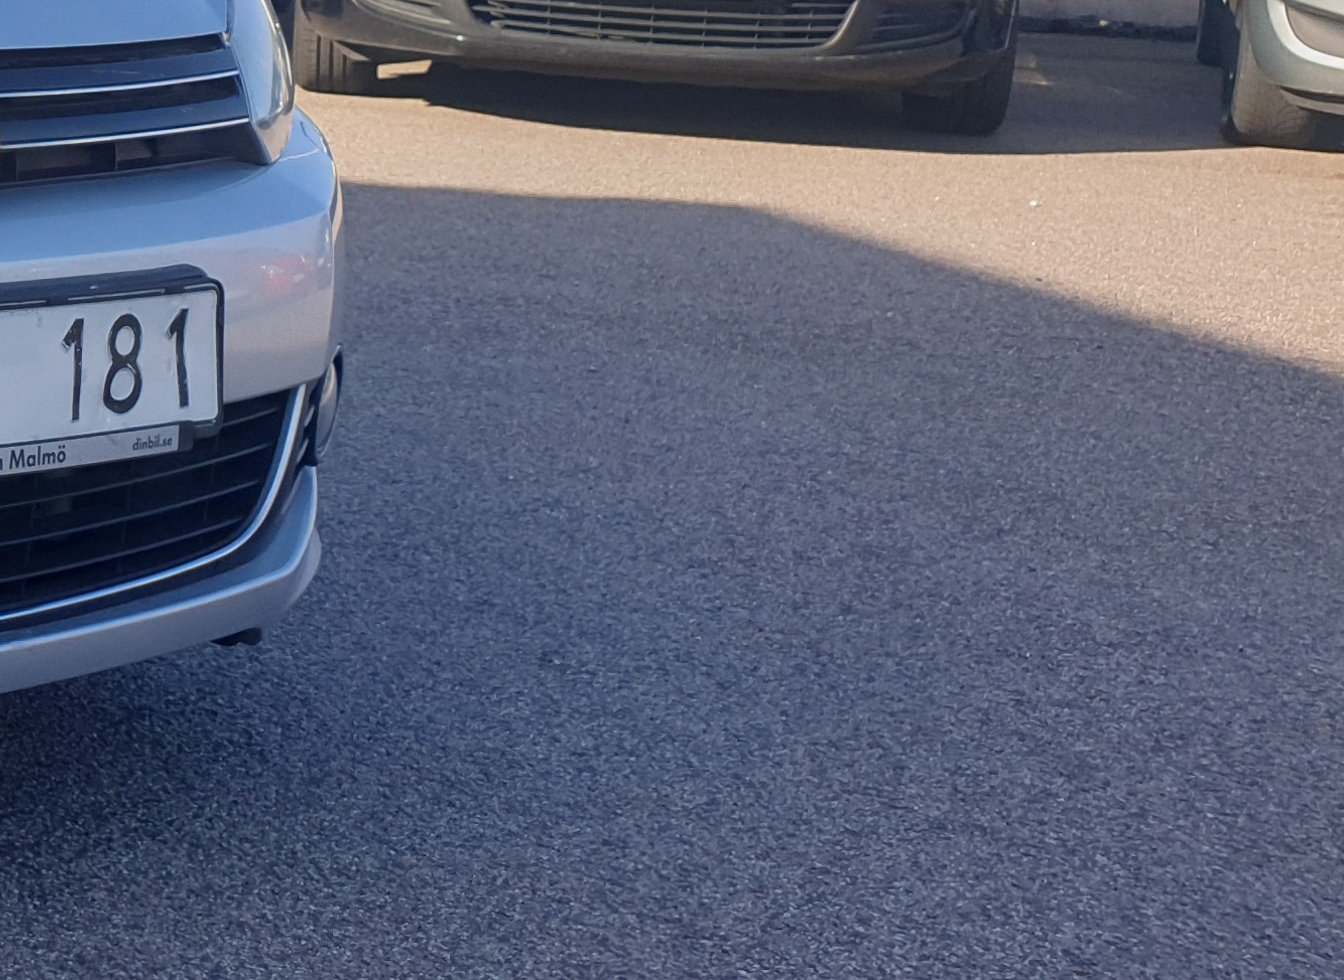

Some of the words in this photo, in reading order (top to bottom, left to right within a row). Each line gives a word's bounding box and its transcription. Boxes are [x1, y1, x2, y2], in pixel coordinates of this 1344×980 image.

[61, 308, 190, 421] 181
[132, 433, 173, 451] dinbil.se
[9, 445, 67, 471] Malmö
